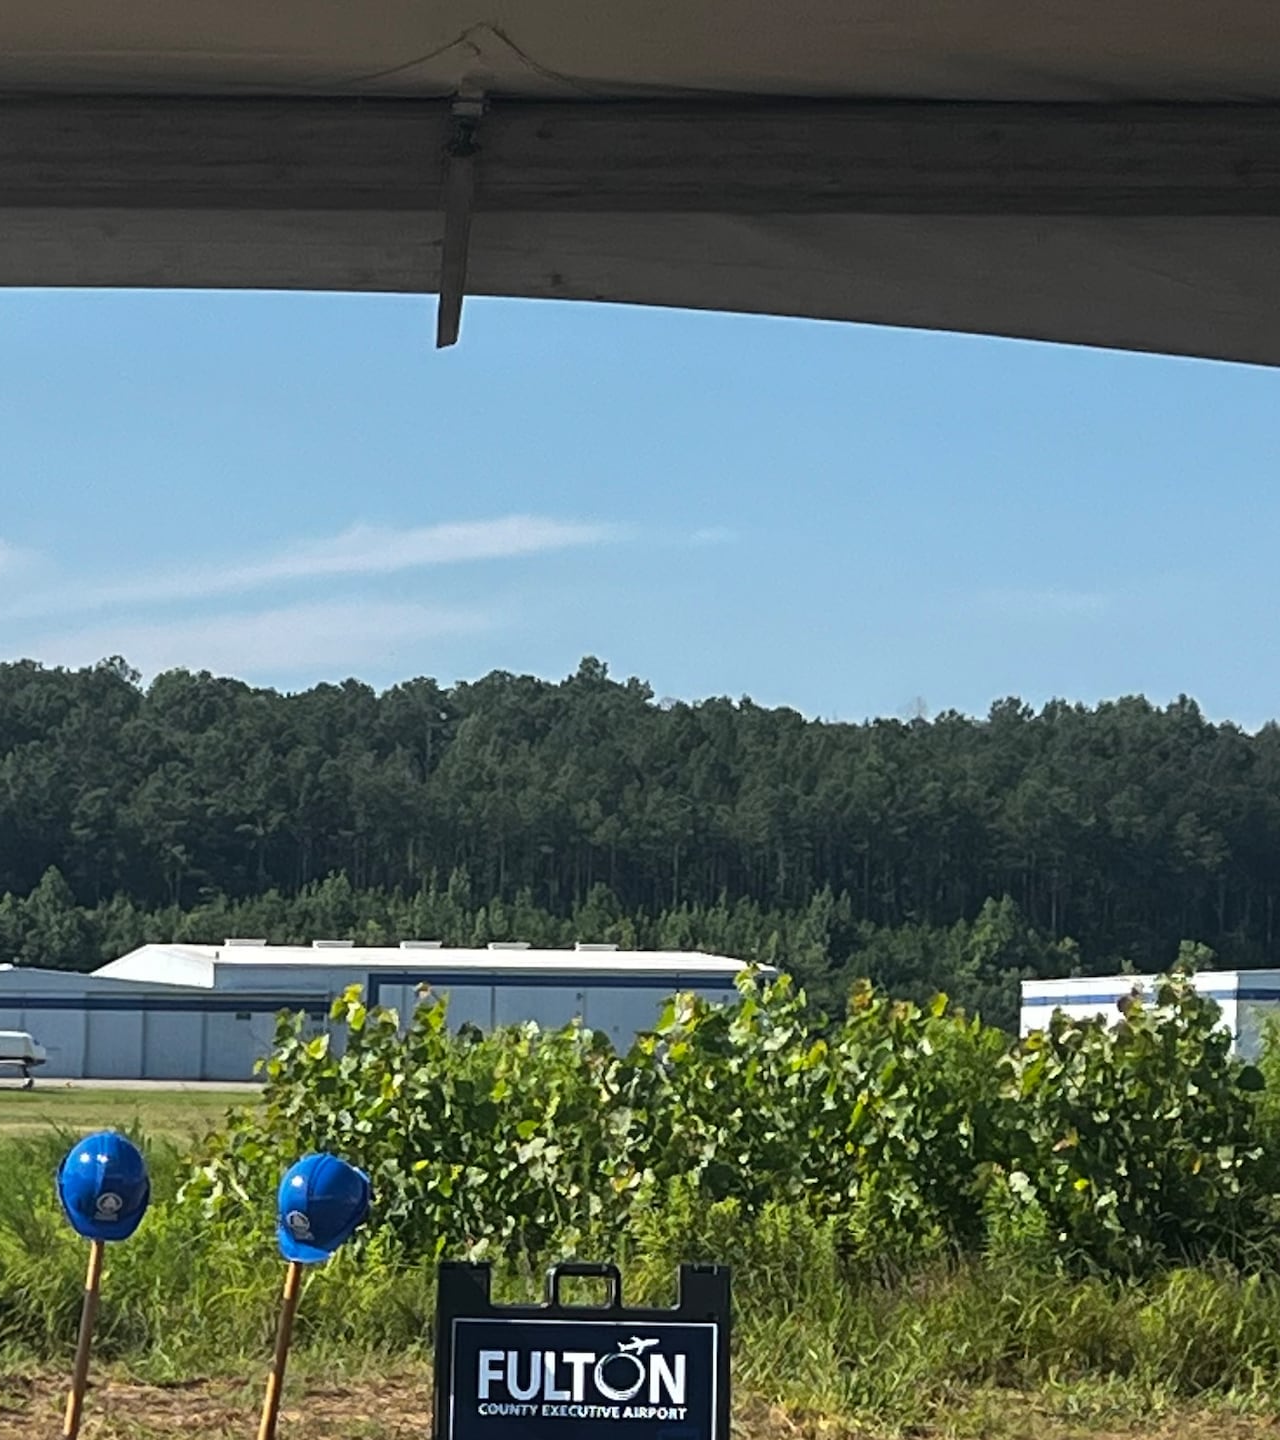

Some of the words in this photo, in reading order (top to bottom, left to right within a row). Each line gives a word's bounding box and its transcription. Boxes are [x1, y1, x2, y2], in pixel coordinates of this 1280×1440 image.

[478, 1350, 686, 1405] FULTON
[478, 1403, 538, 1417] COUNTY
[542, 1404, 620, 1419] EXECUTIVE
[623, 1405, 687, 1421] AIRPORT
